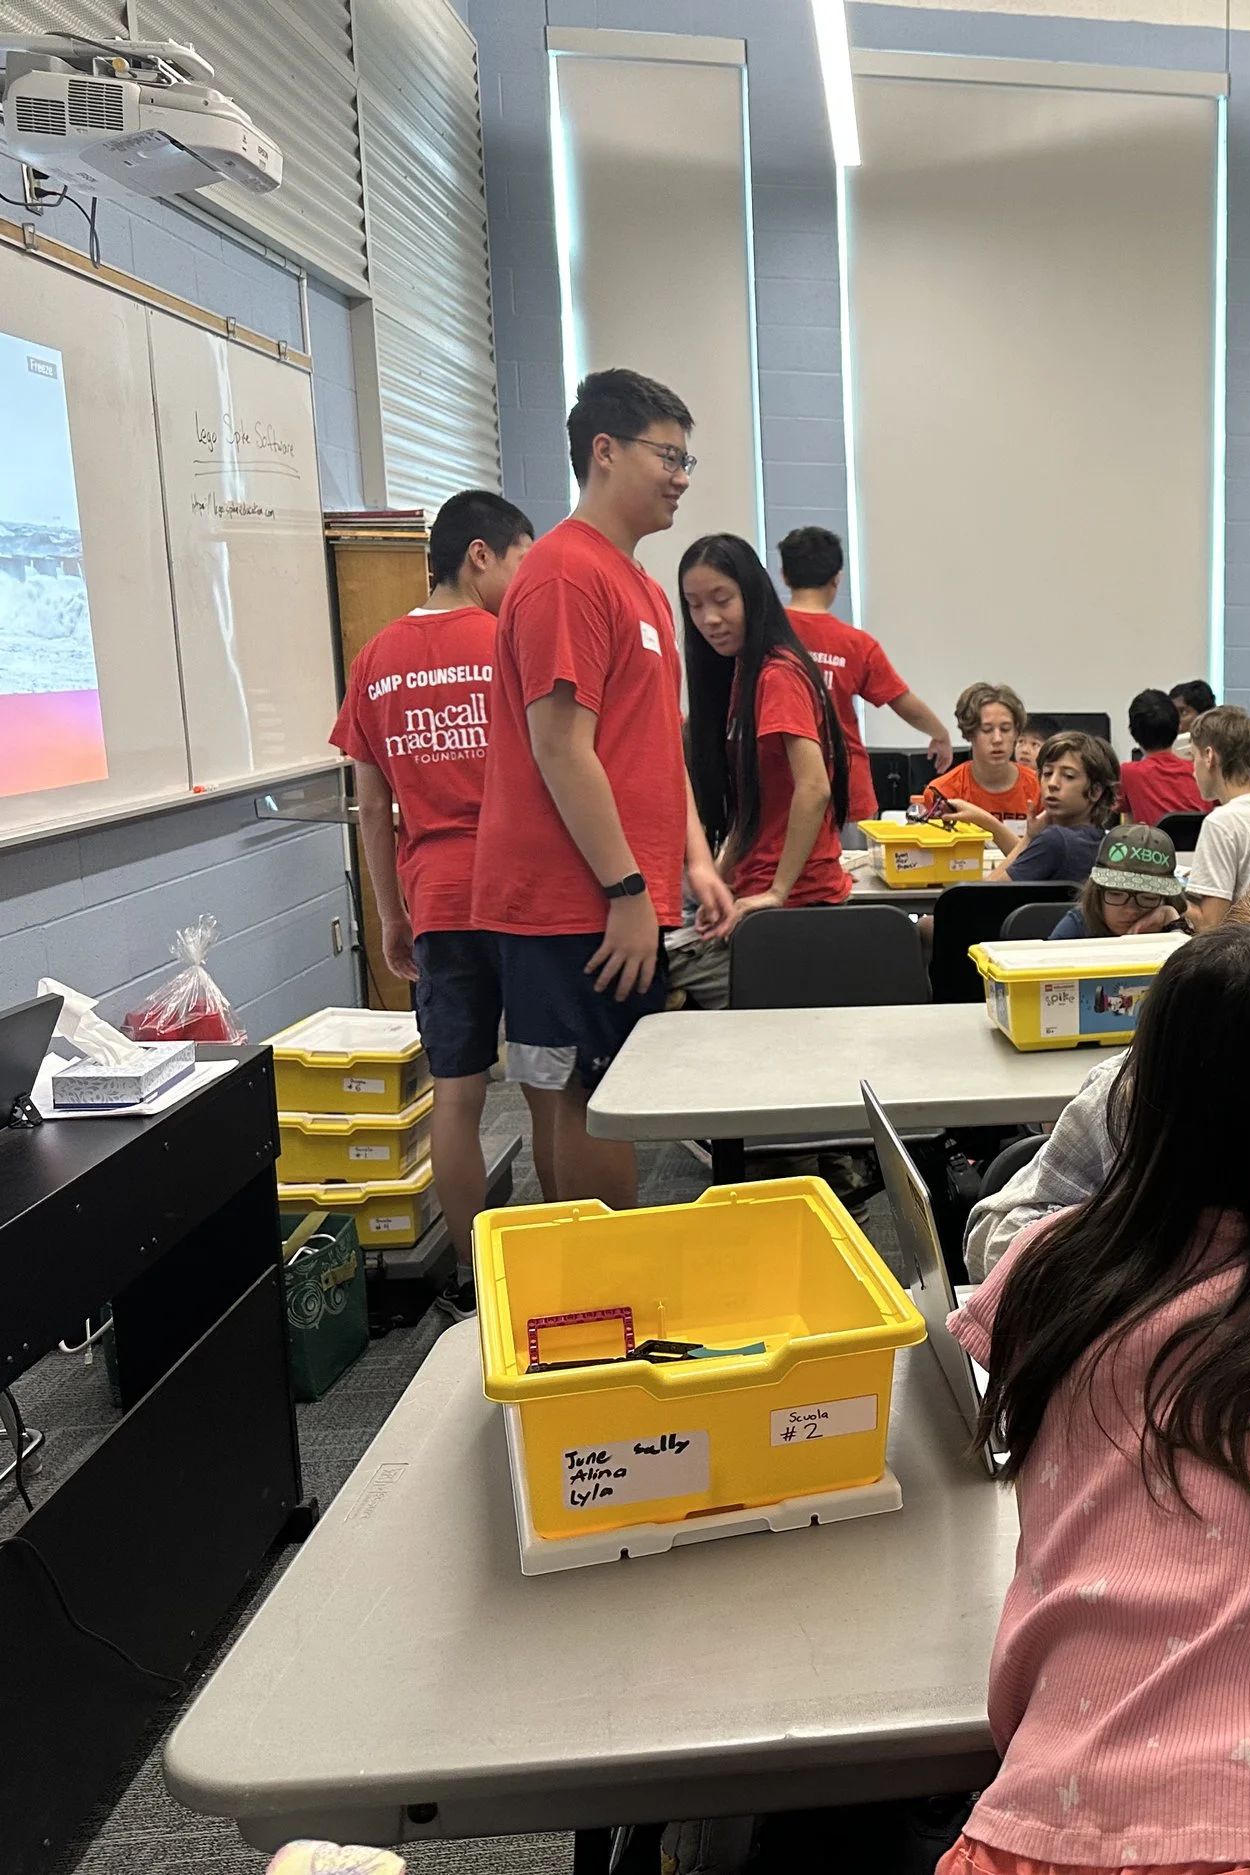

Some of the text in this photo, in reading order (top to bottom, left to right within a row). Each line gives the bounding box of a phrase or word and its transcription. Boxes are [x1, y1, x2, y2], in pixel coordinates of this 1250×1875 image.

[30, 358, 54, 377] Freeze
[195, 410, 217, 453] Lego
[255, 420, 295, 457] Software
[367, 664, 493, 701] CAMP COUNSELLO
[405, 693, 489, 732] mccall
[385, 726, 489, 758] macbain
[1129, 846, 1170, 868] XBOX
[789, 1408, 829, 1423] Scuola
[780, 1422, 823, 1441] # 2
[565, 1450, 613, 1470] June
[570, 1467, 628, 1486] Alina
